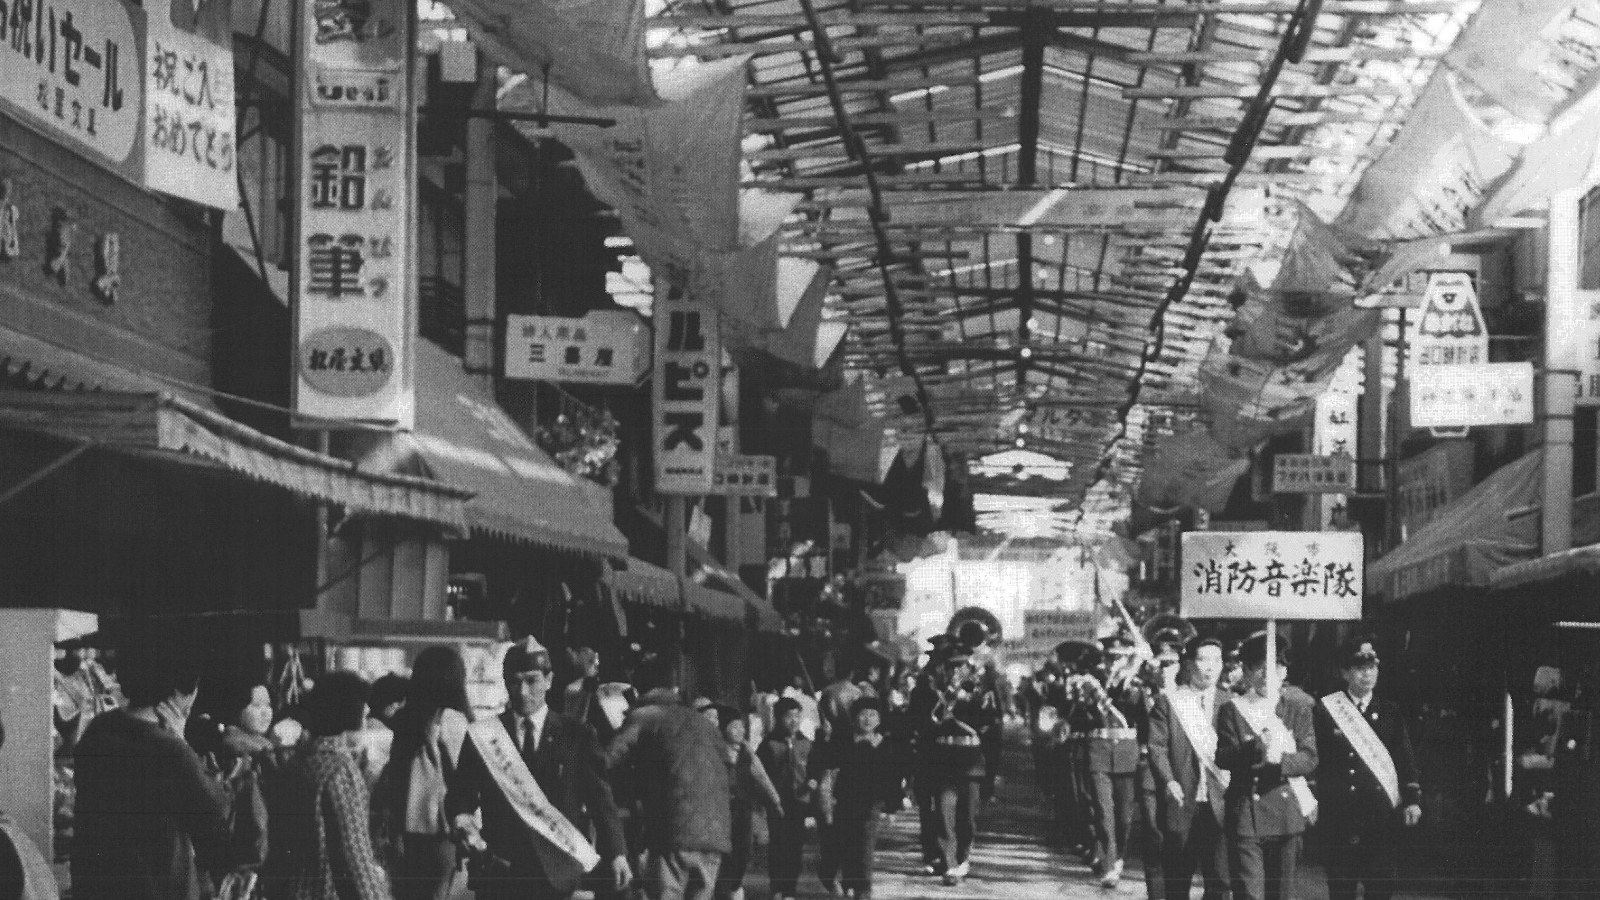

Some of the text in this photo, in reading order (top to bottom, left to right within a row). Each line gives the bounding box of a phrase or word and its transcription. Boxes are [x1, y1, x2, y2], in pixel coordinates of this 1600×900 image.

[1193, 558, 1358, 598] 消防音楽隊
